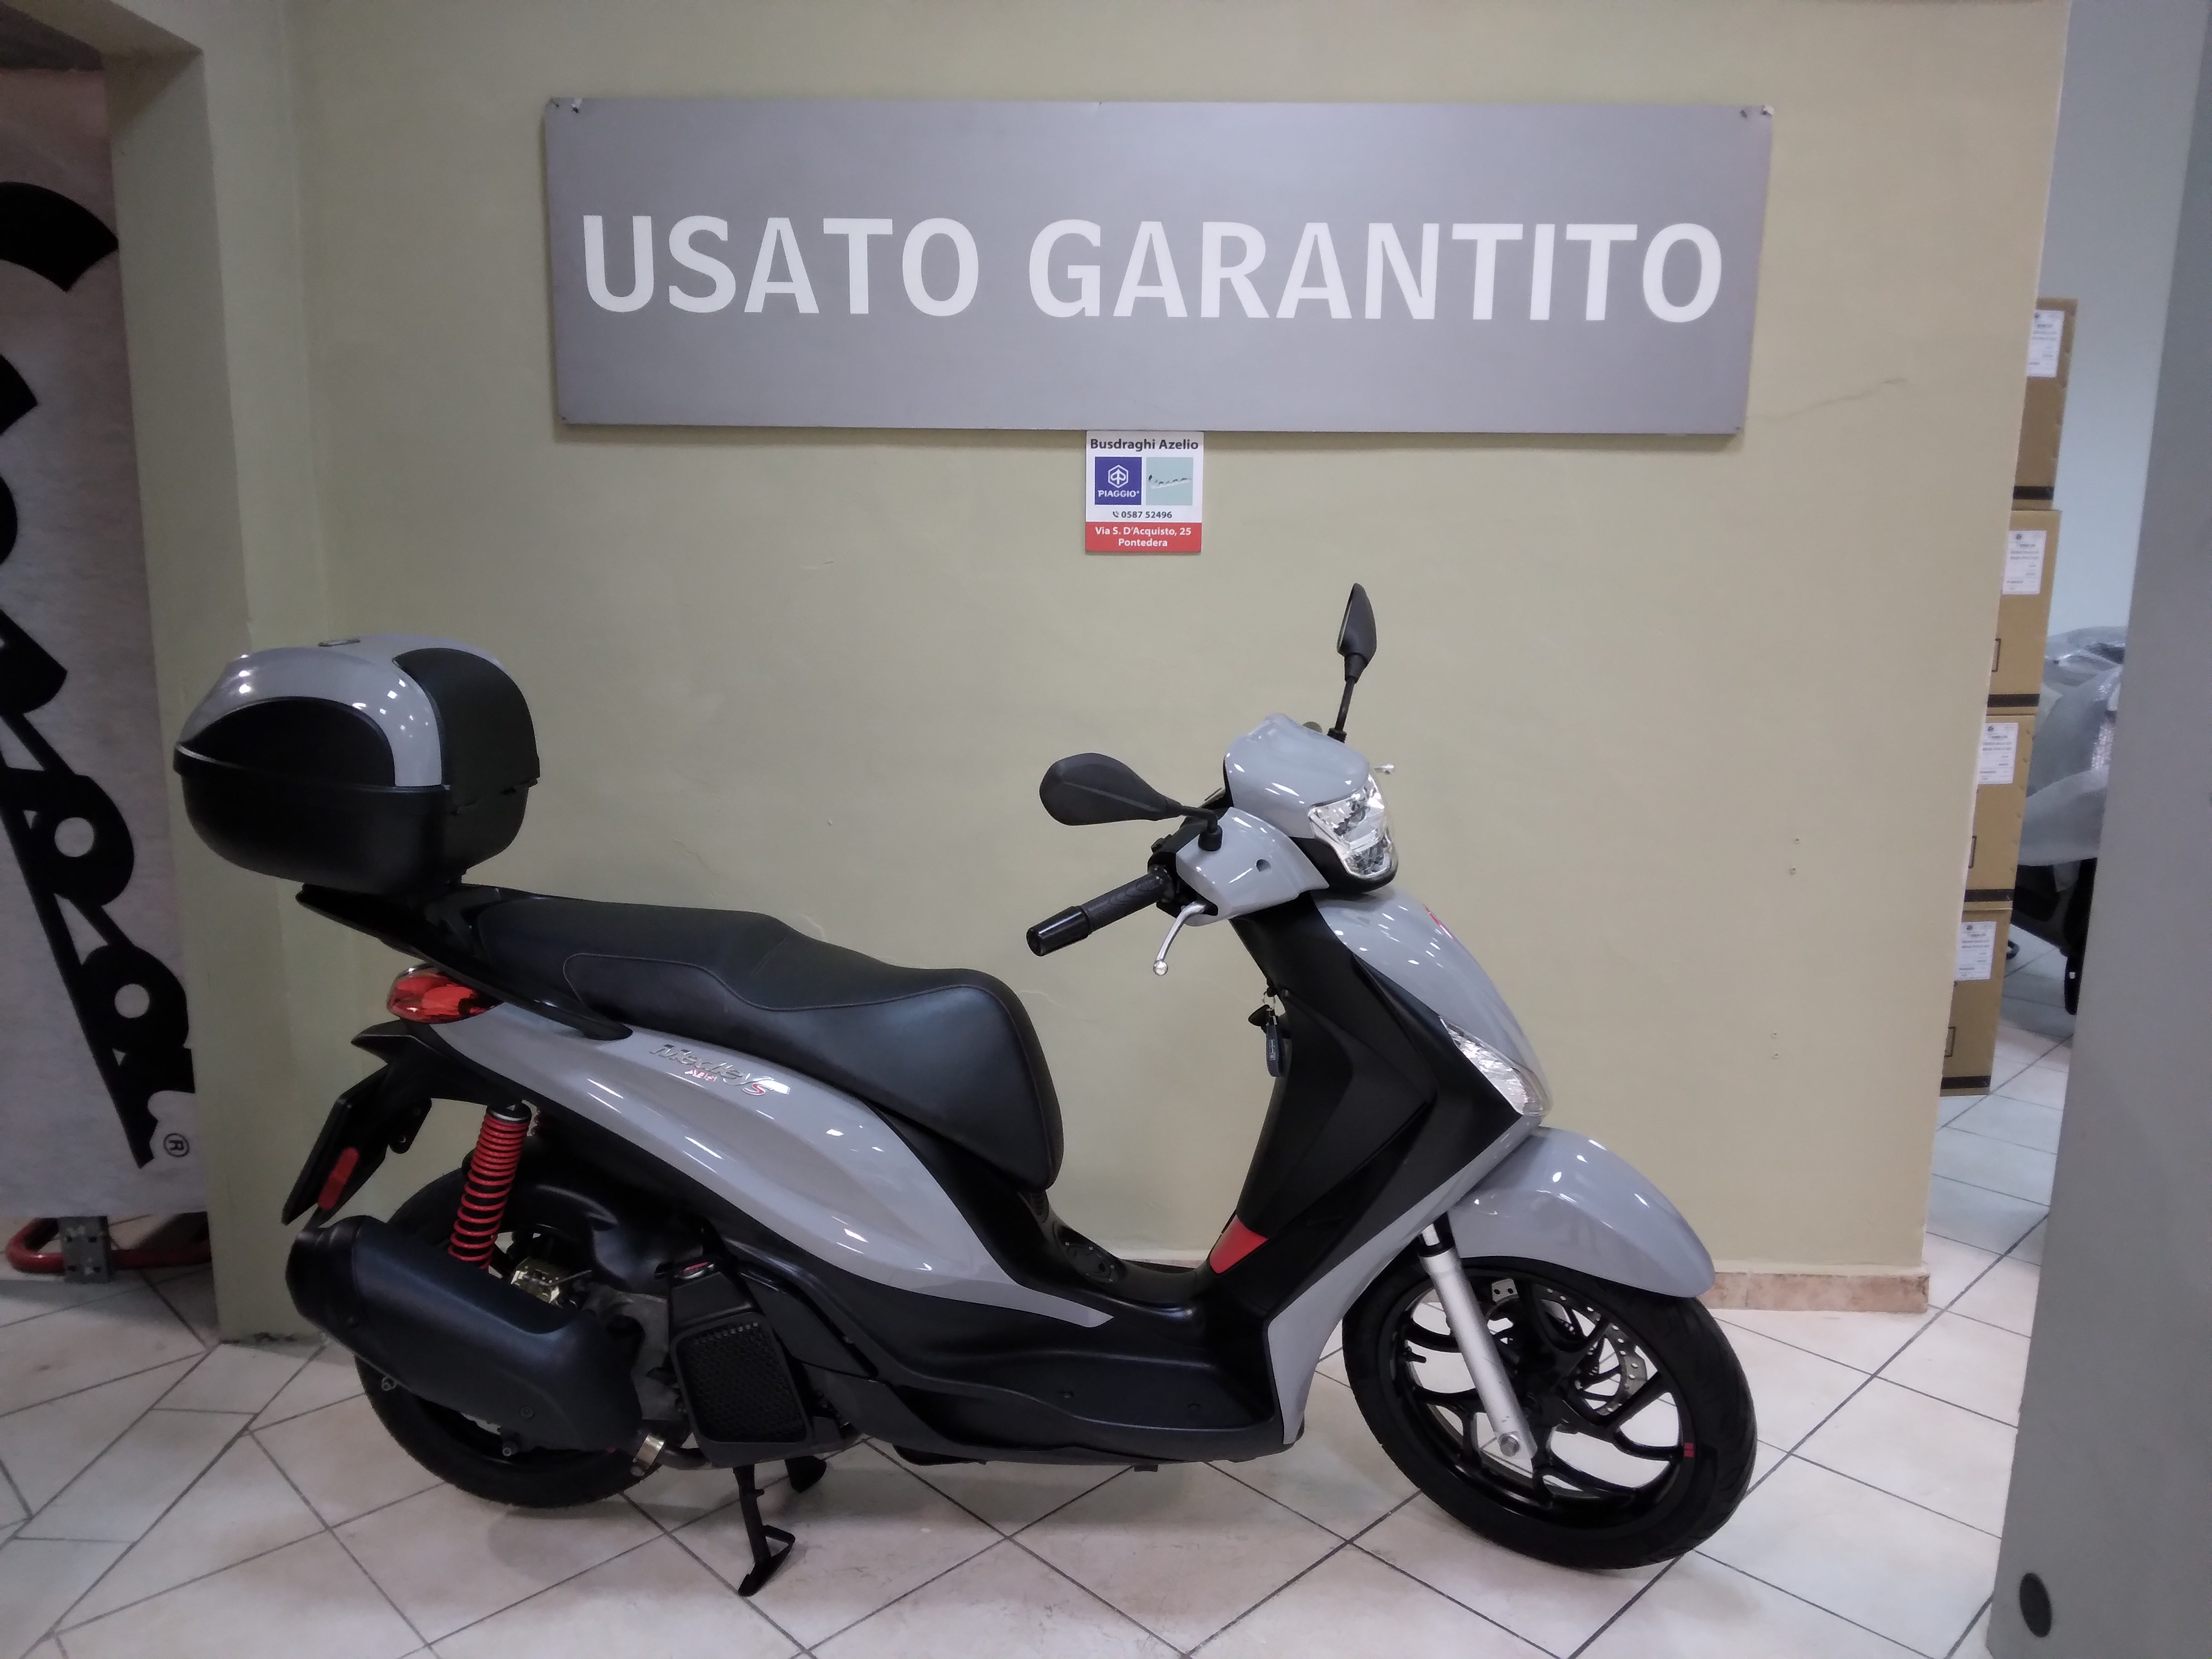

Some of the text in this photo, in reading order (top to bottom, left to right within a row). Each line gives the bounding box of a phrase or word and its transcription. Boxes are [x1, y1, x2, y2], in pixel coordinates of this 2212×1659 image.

[583, 215, 1722, 323] USATO GARANTITO
[1090, 438, 1199, 452] Busdraghi Azelio
[1095, 526, 1192, 537] Via S. D'Acquisto, 25
[1118, 538, 1168, 547] Pontedera
